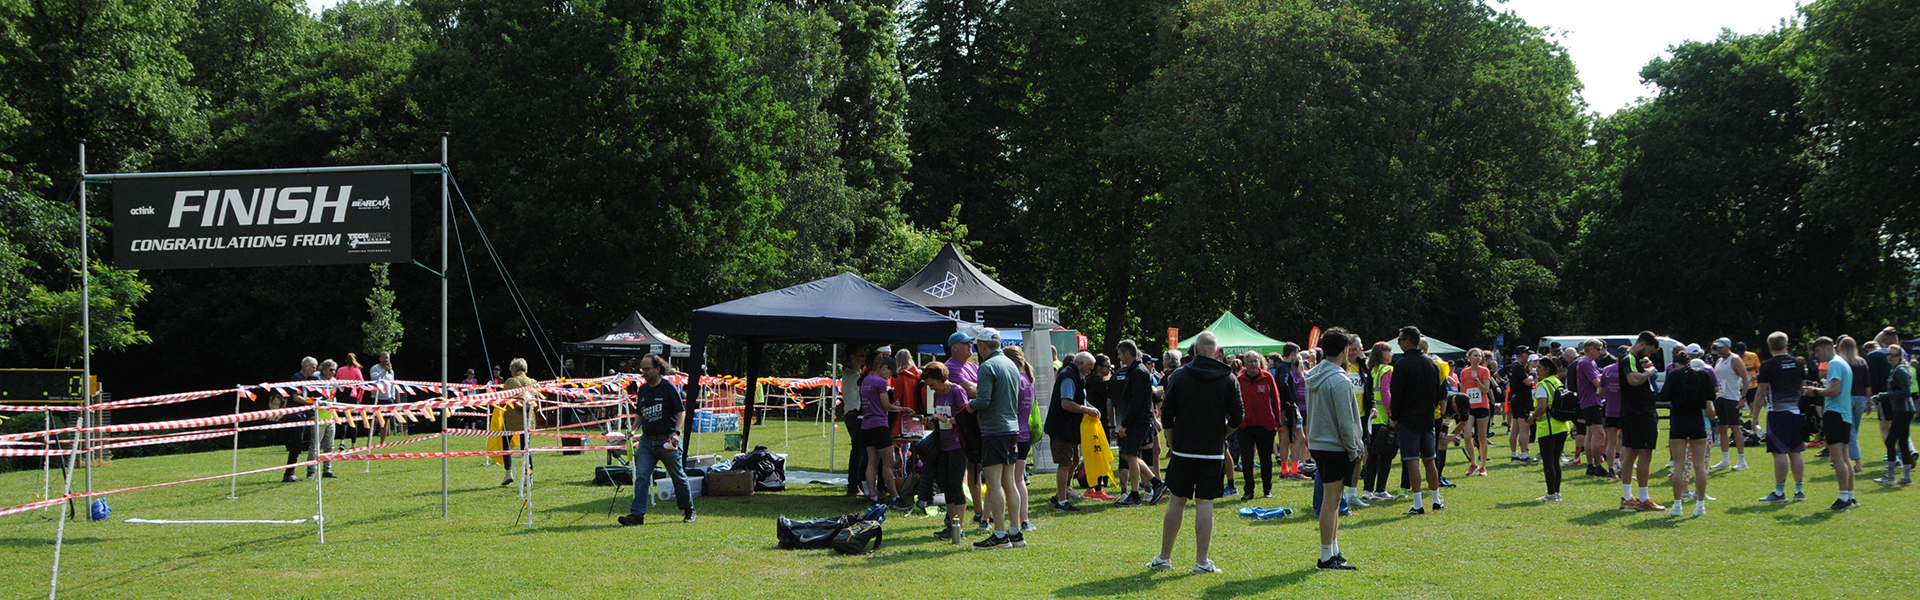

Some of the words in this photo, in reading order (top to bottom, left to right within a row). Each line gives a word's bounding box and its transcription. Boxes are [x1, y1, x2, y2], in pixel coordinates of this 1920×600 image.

[130, 205, 155, 215] octink
[168, 185, 353, 228] FINISH
[130, 235, 287, 252] CONGRATULATIONS
[292, 233, 342, 247] FROM
